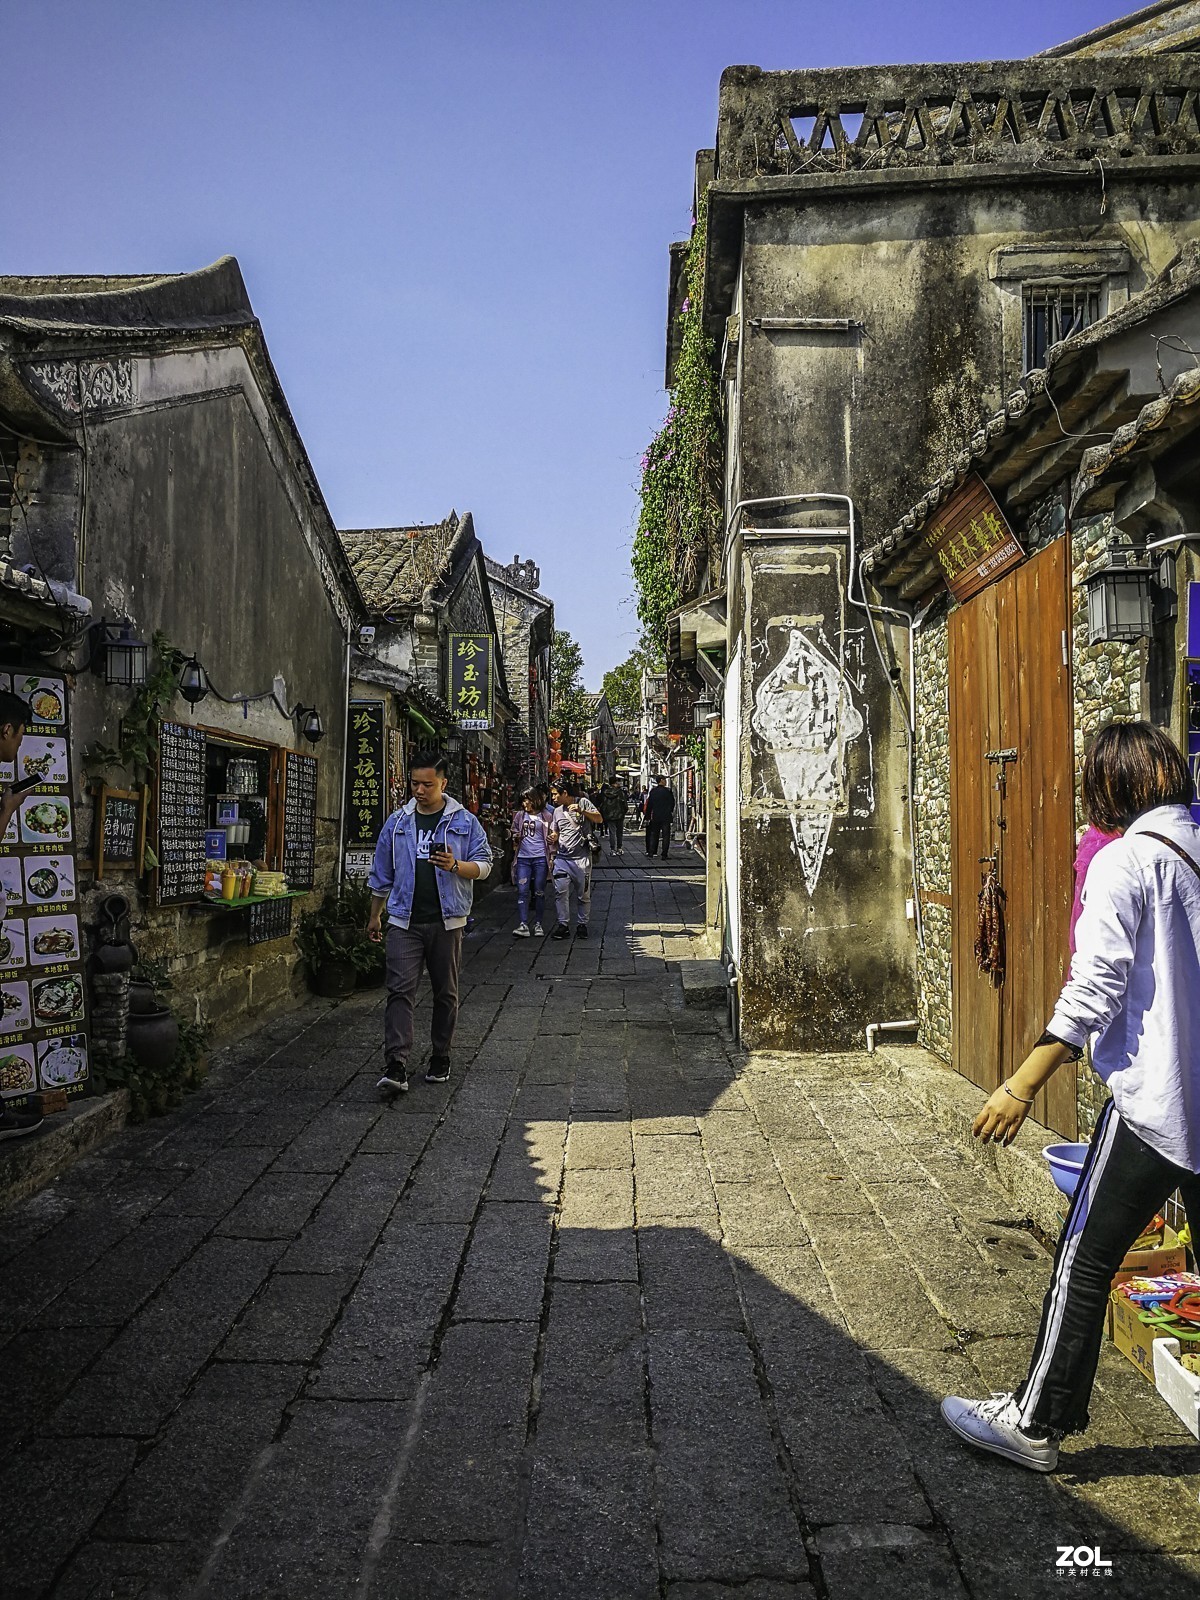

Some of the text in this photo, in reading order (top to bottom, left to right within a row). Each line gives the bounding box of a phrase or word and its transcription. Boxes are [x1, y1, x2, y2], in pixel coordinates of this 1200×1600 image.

[457, 639, 485, 707] 珍玉坊
[352, 711, 377, 778] 珍玉坊
[106, 801, 136, 819] 空调开放
[358, 809, 373, 838] 饰品
[33, 844, 64, 853] 土豆牛肉饭
[346, 853, 376, 867] 卫生
[37, 904, 68, 913] 梅菜扣肉饭
[46, 1024, 77, 1036] 红烧排骨面
